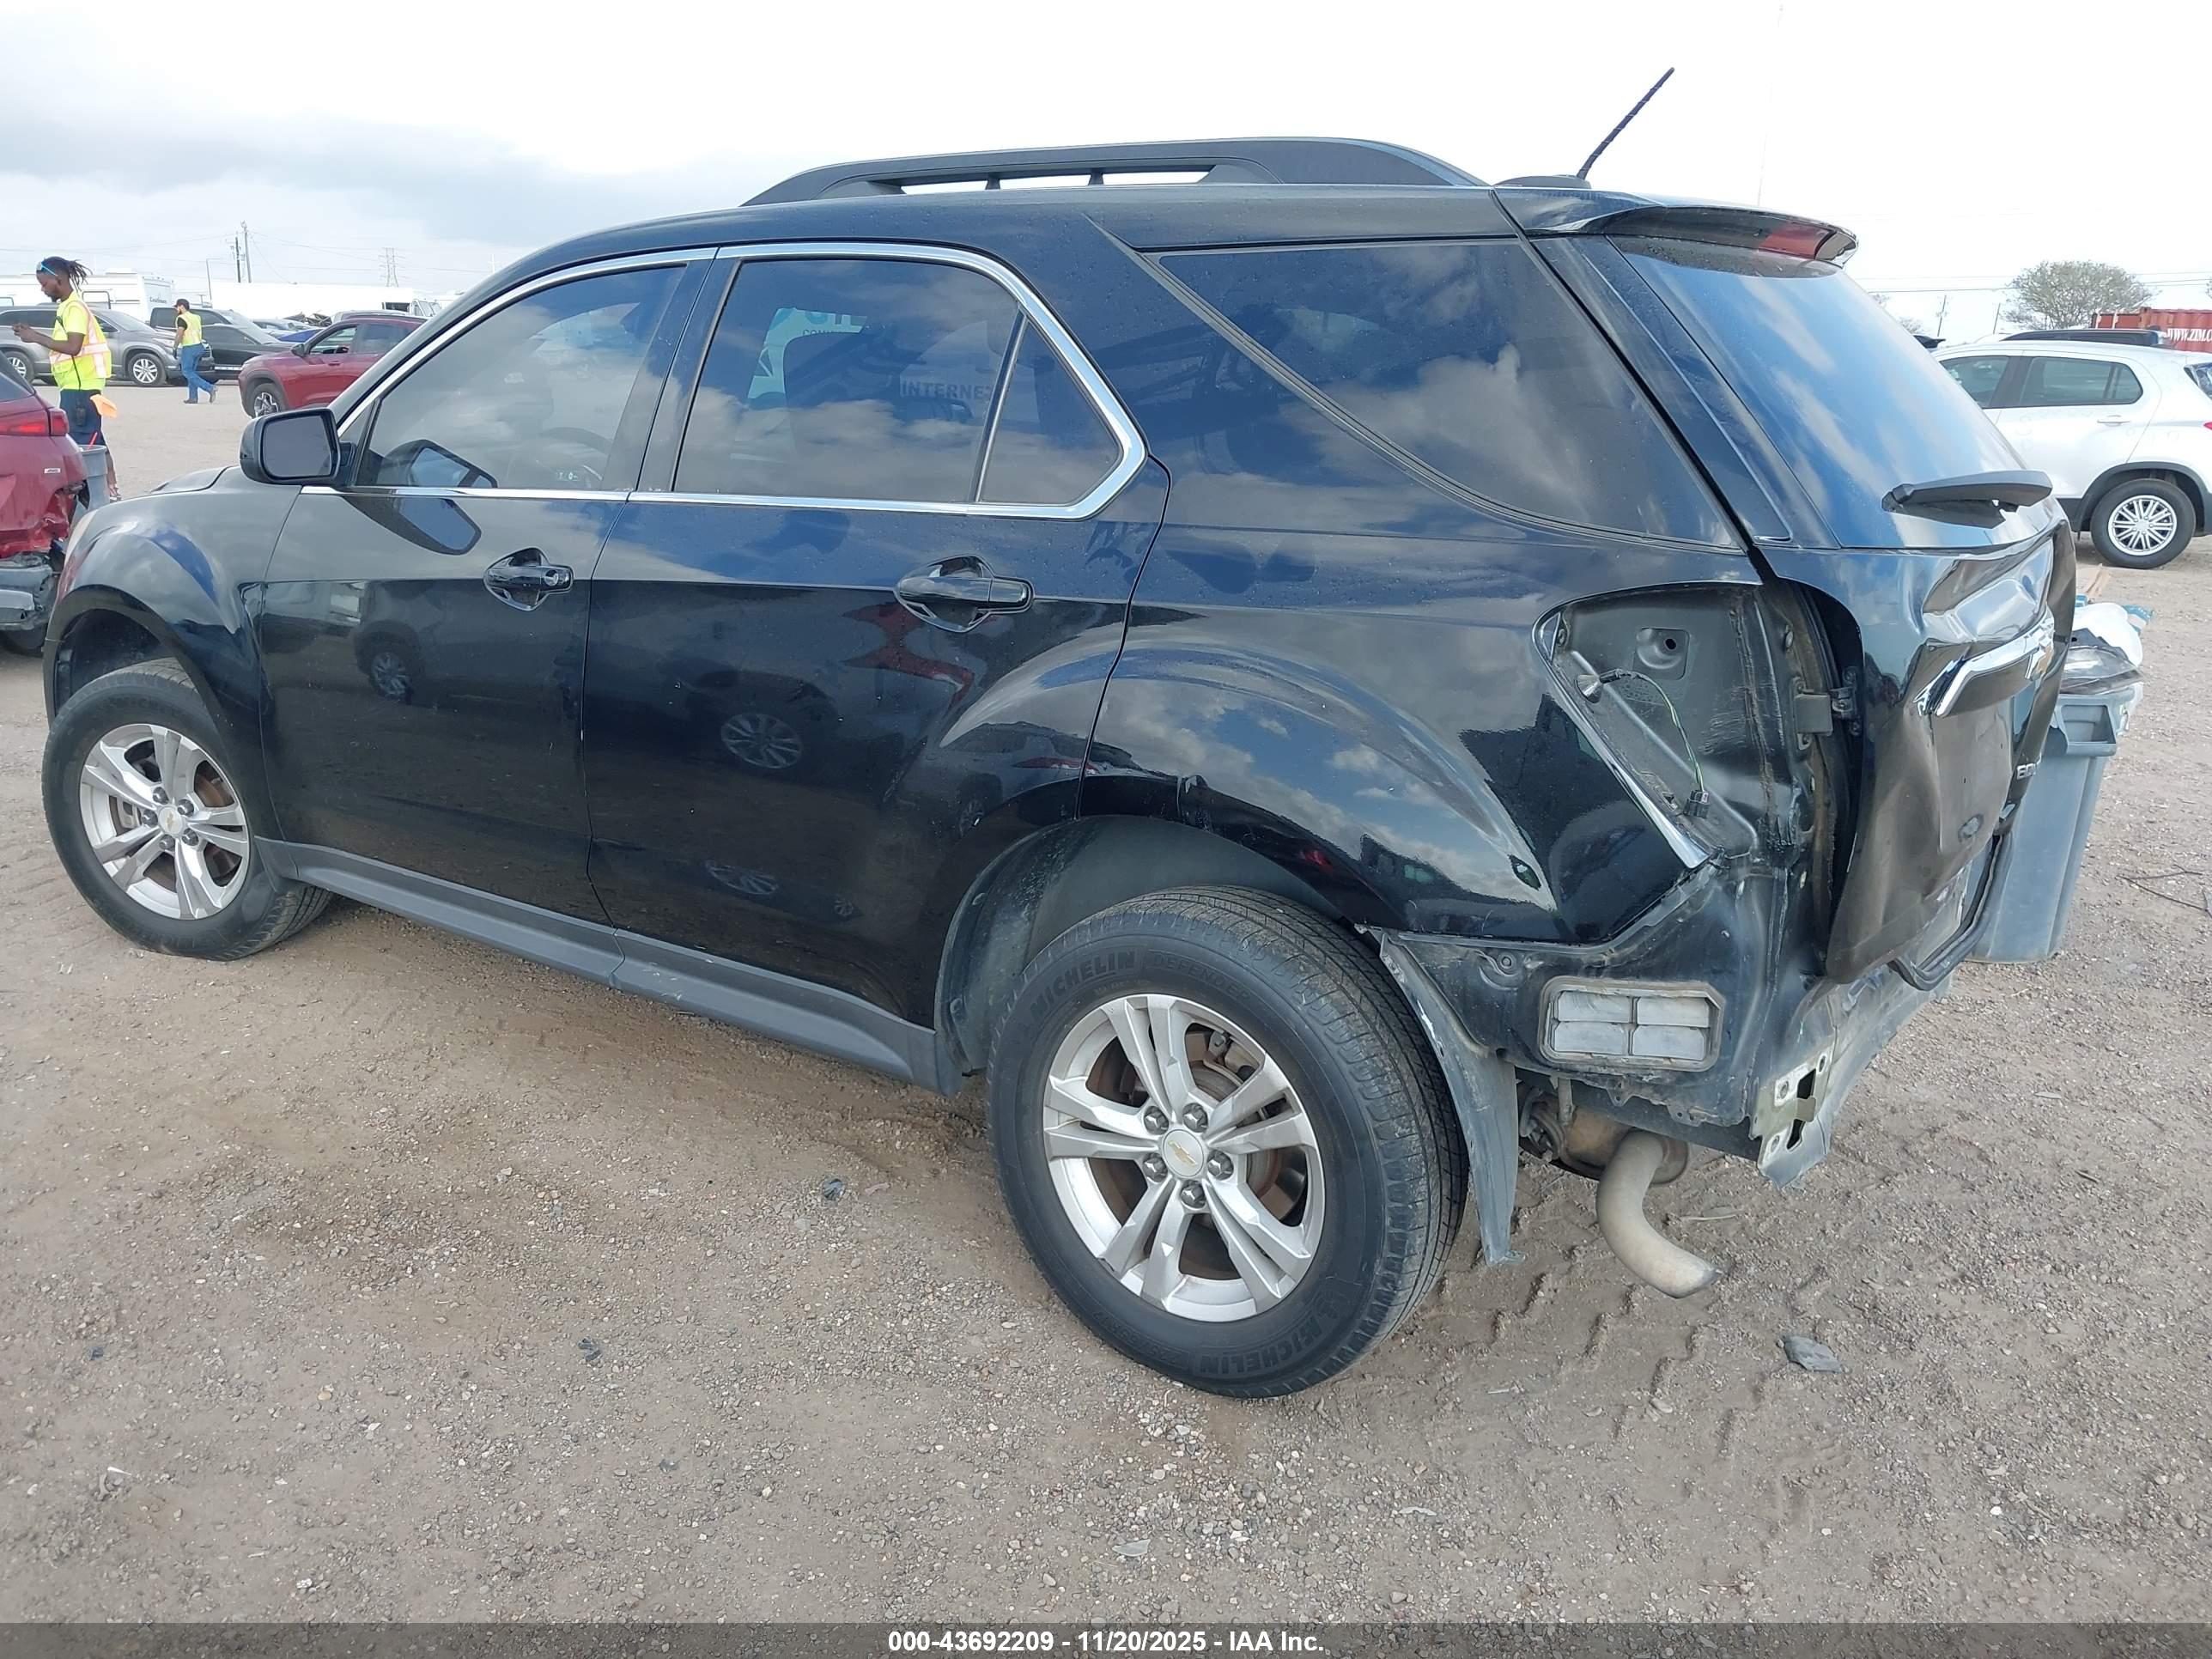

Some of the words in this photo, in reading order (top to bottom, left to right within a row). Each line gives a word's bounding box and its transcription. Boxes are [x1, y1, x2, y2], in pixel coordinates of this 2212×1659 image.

[1030, 950, 1136, 1020] MICHELIN
[1152, 951, 1253, 1000] DEFENDER
[1200, 1317, 1324, 1376] MICHELIN
